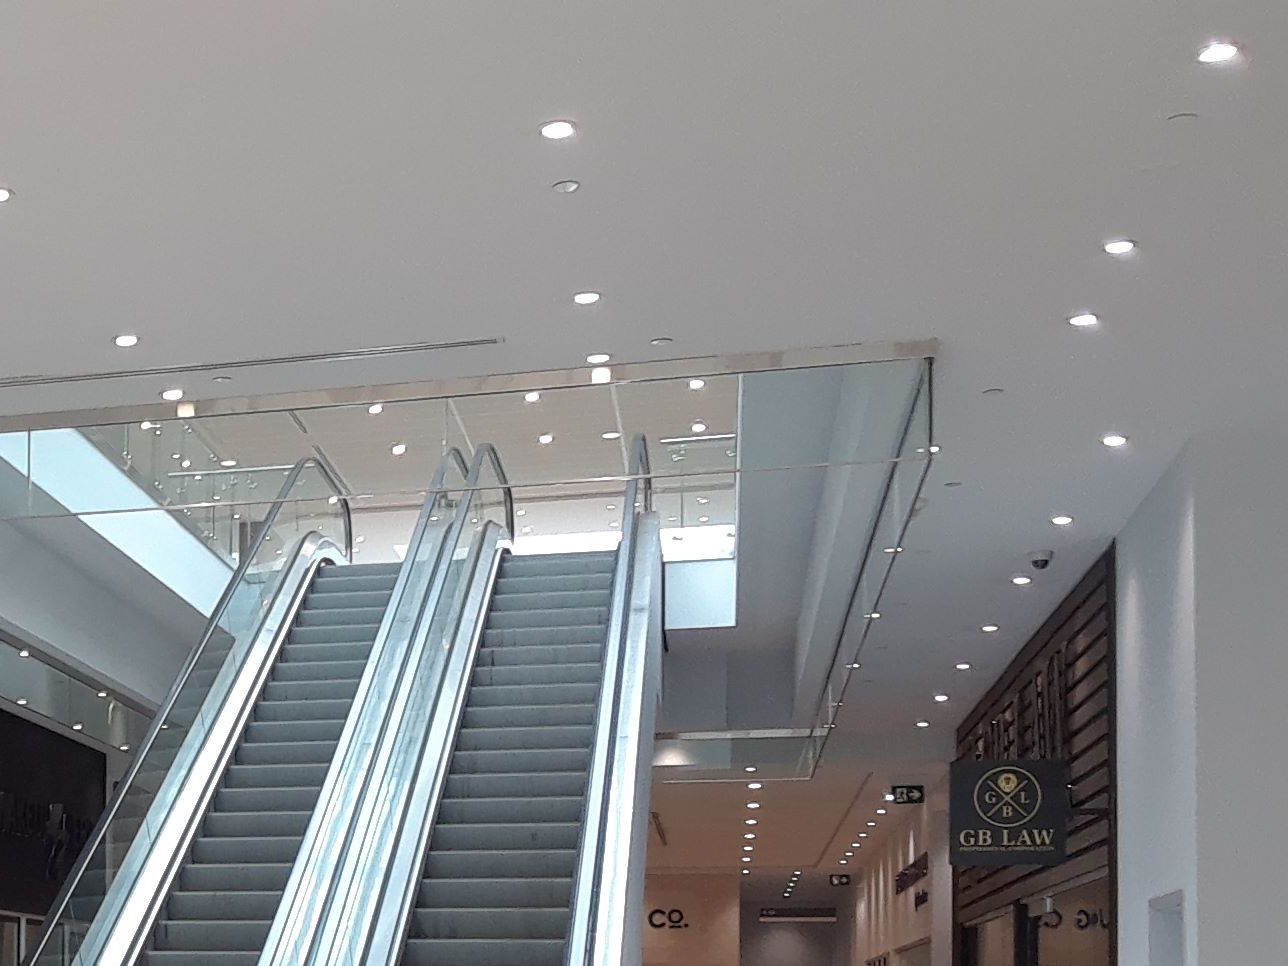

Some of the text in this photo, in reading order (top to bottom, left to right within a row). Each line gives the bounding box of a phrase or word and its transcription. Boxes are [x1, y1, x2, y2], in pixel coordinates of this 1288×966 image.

[985, 791, 996, 803] G
[1020, 791, 1030, 803] L
[1002, 805, 1013, 817] B
[959, 829, 1054, 846] GB LAW
